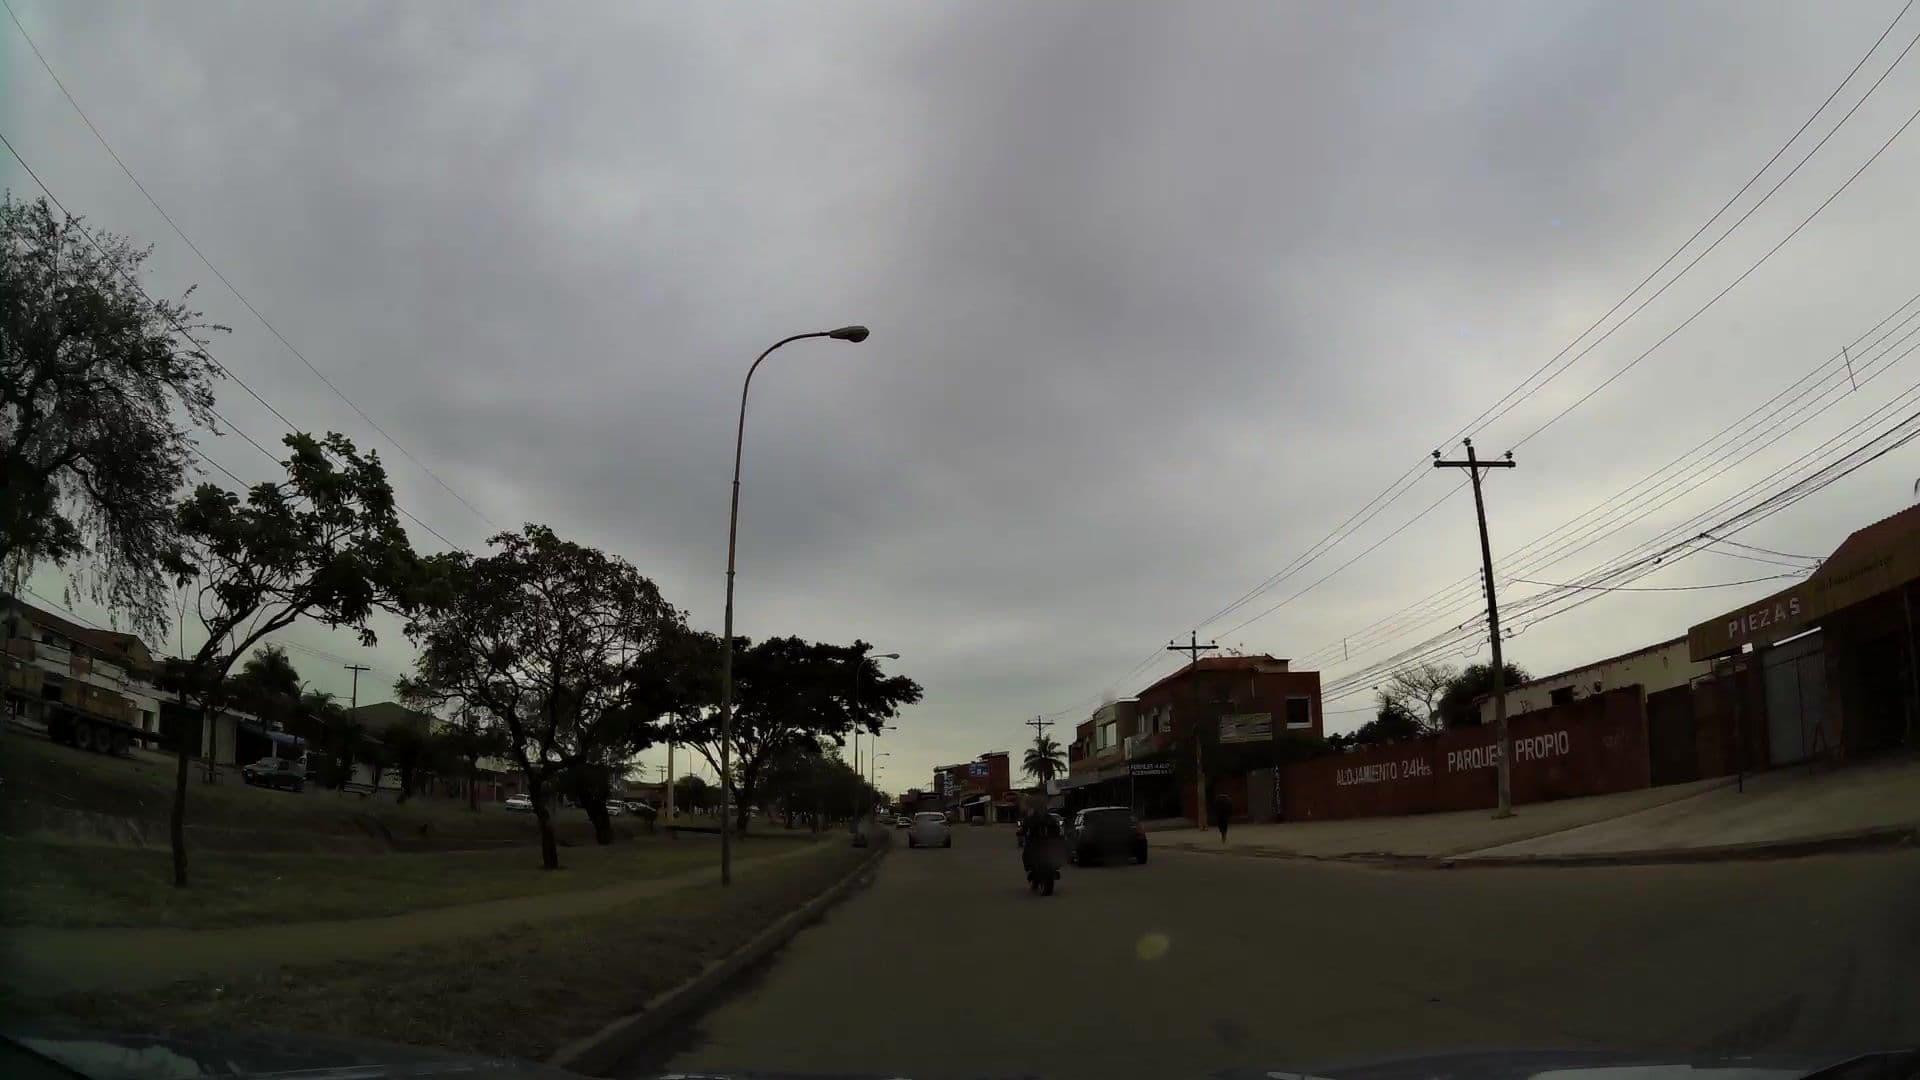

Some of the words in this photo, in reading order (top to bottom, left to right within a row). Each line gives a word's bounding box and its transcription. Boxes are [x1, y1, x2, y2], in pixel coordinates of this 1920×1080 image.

[1728, 597, 1801, 638] PIEZAS
[1447, 744, 1504, 774] PARQUE
[1515, 730, 1570, 763] PROPIO
